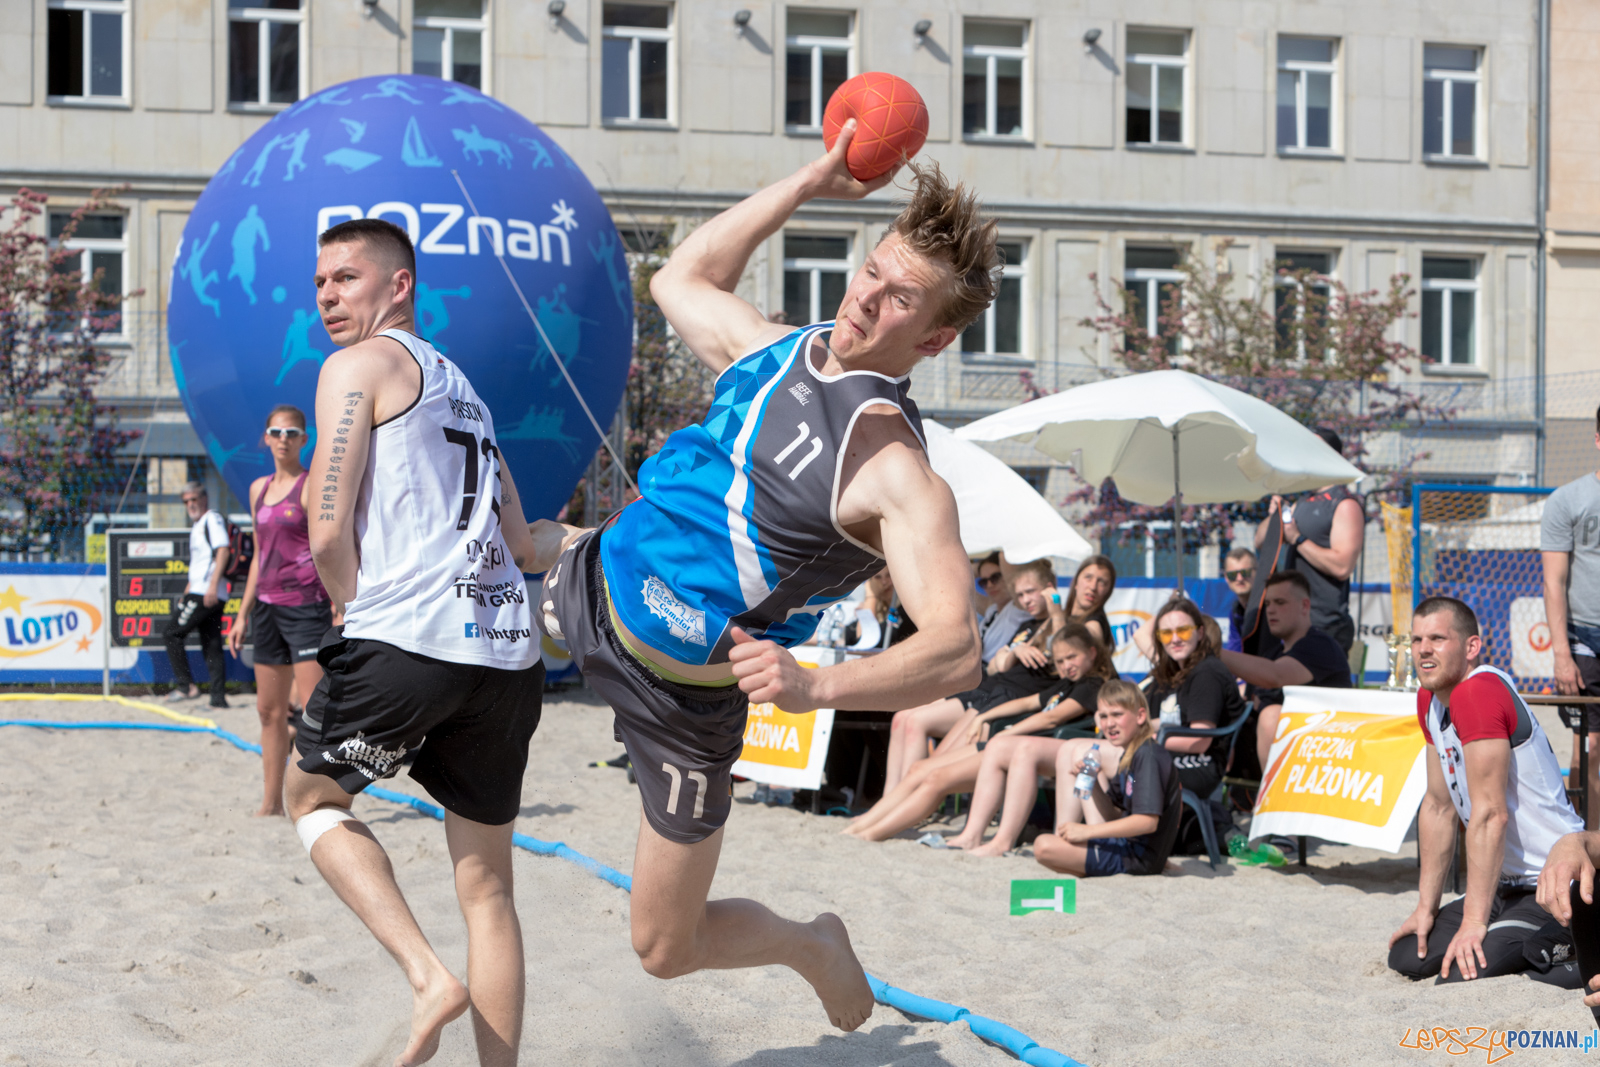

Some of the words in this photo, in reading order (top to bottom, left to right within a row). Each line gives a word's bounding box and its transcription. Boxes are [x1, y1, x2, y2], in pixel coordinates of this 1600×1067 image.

[773, 421, 824, 481] 11
[129, 577, 144, 596] 6
[5, 610, 79, 646] LOTTO
[121, 617, 152, 637] 00
[659, 602, 691, 632] Camelot
[1297, 735, 1358, 763] RĘCZNA
[661, 761, 708, 819] 11
[1284, 759, 1384, 807] PLAŻOWA
